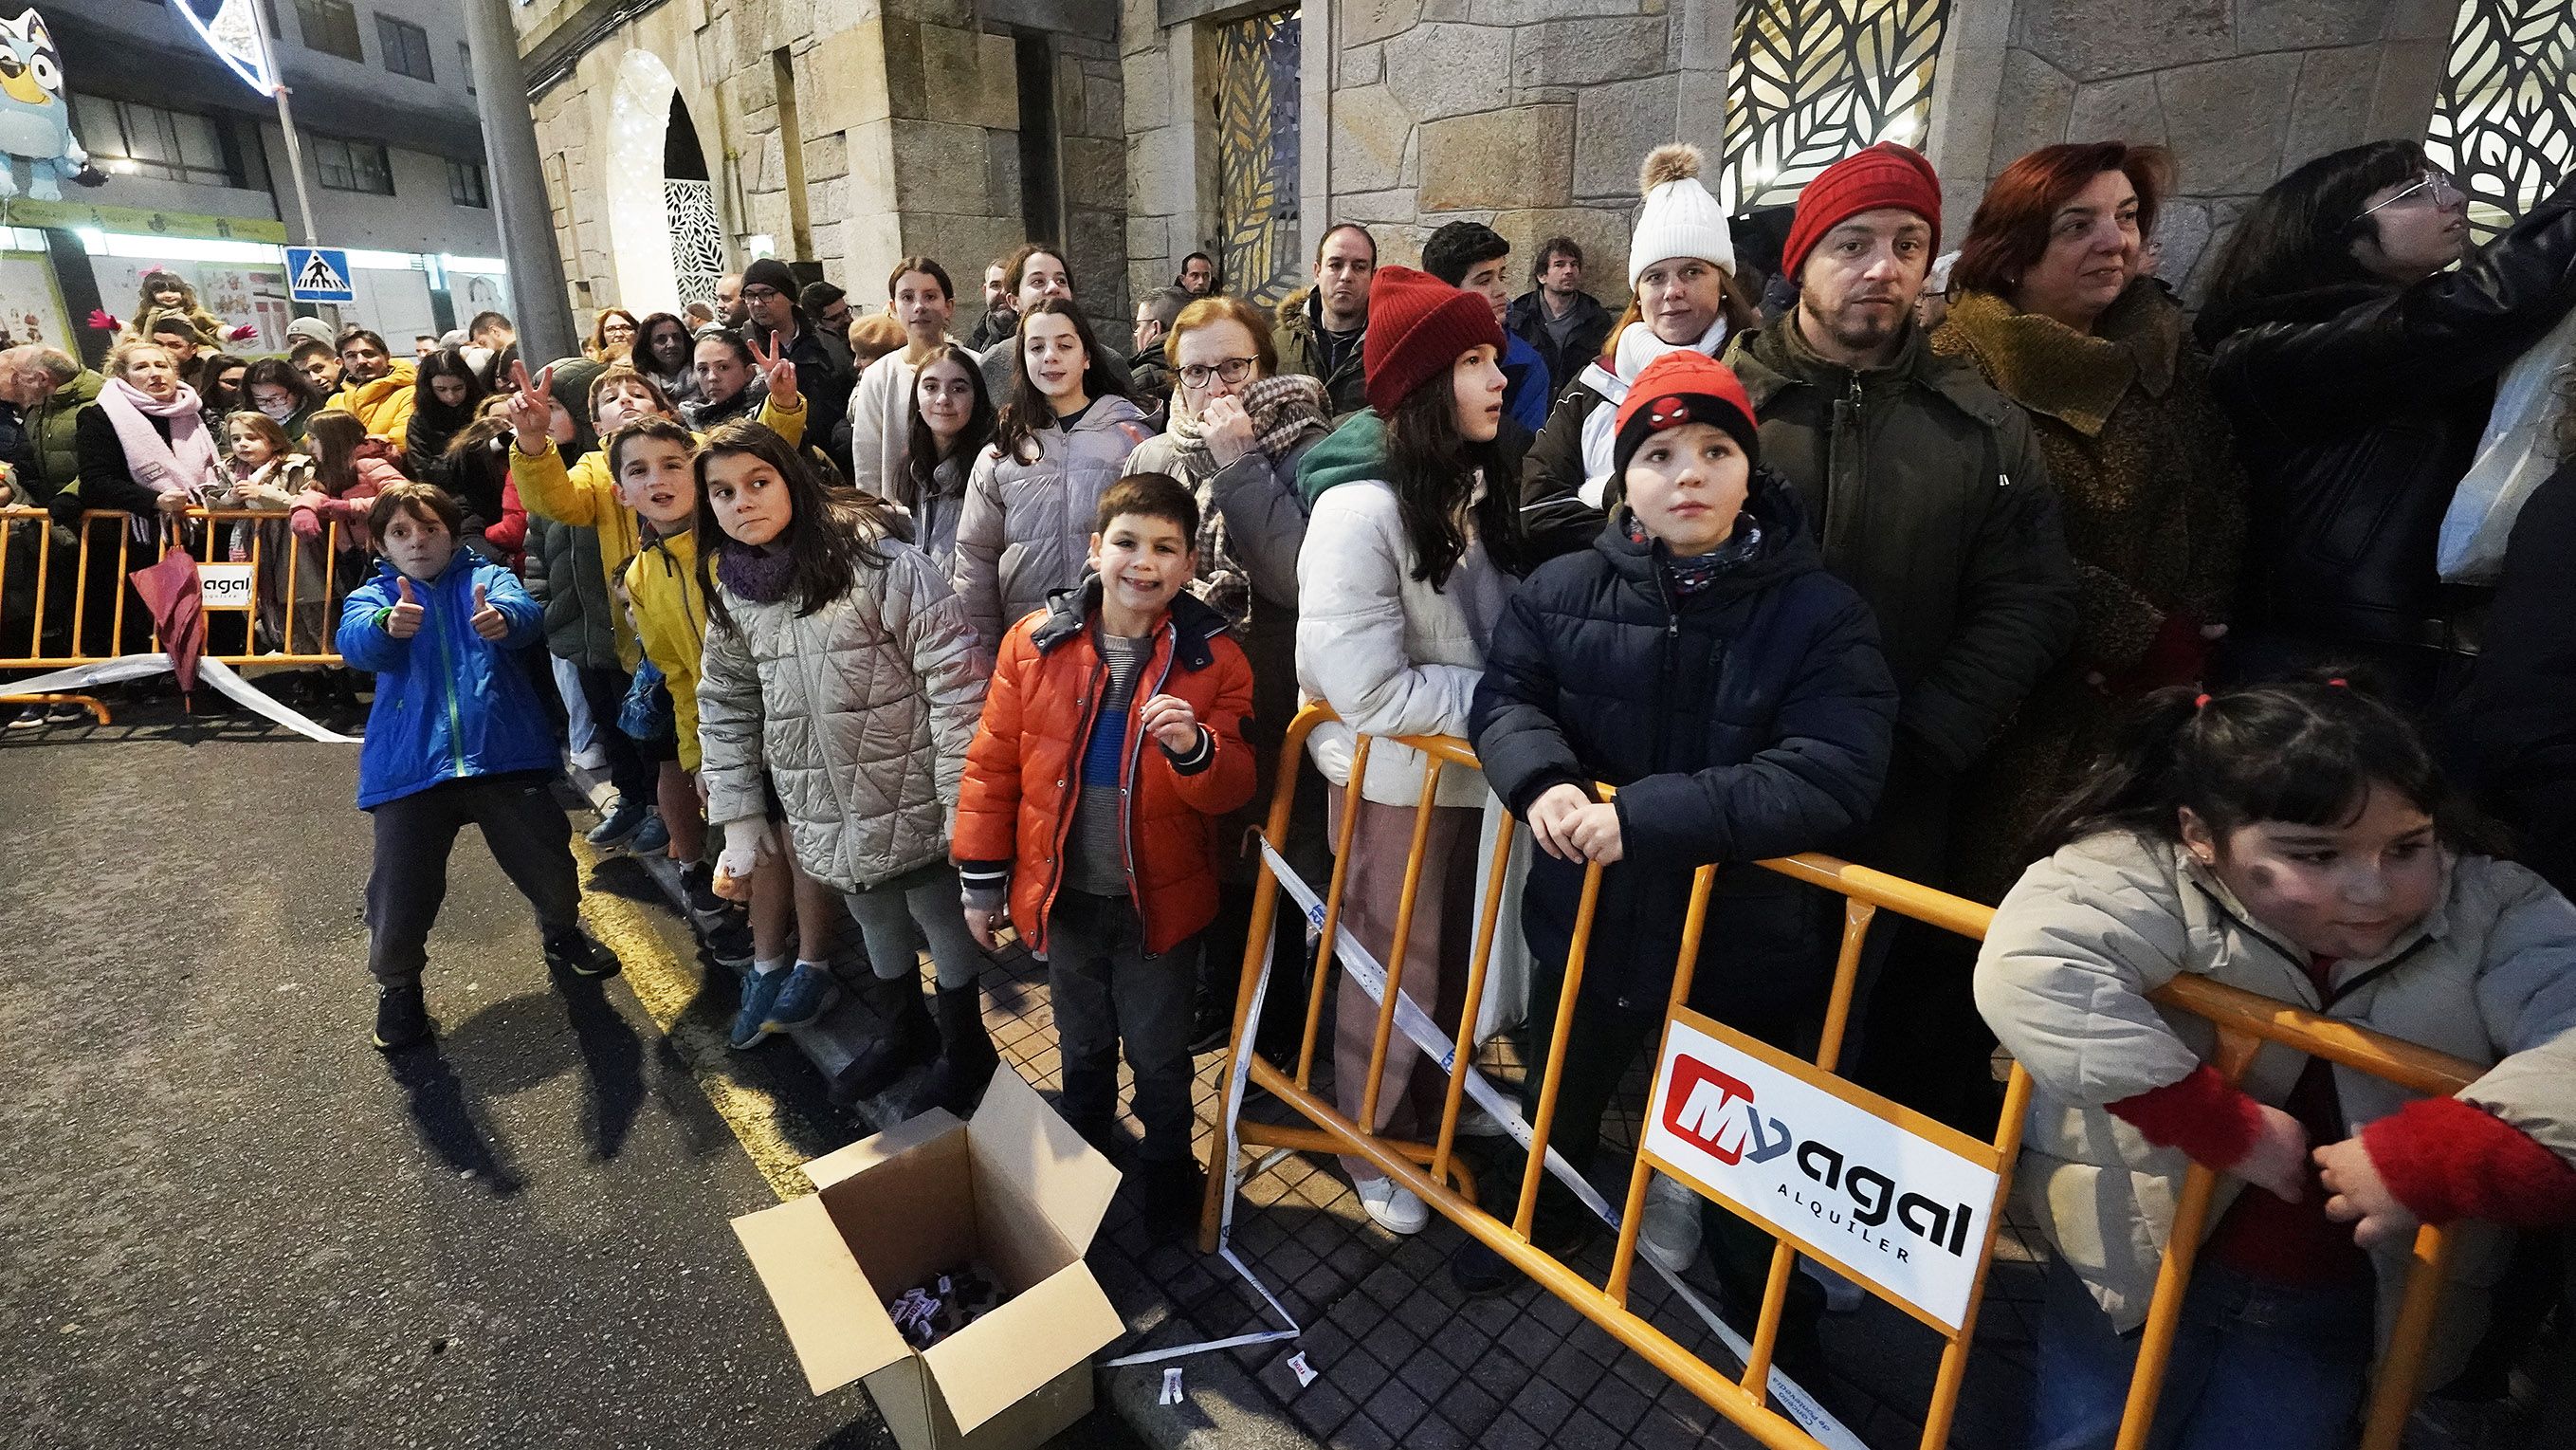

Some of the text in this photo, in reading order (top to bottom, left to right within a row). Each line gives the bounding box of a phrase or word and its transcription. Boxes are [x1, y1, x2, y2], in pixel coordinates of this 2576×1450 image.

[204, 578, 249, 594] agal
[1778, 1184, 1909, 1263] ALQUILER
[1773, 1377, 1830, 1431] de Pontevedra
[1779, 1392, 1813, 1425] Concello
